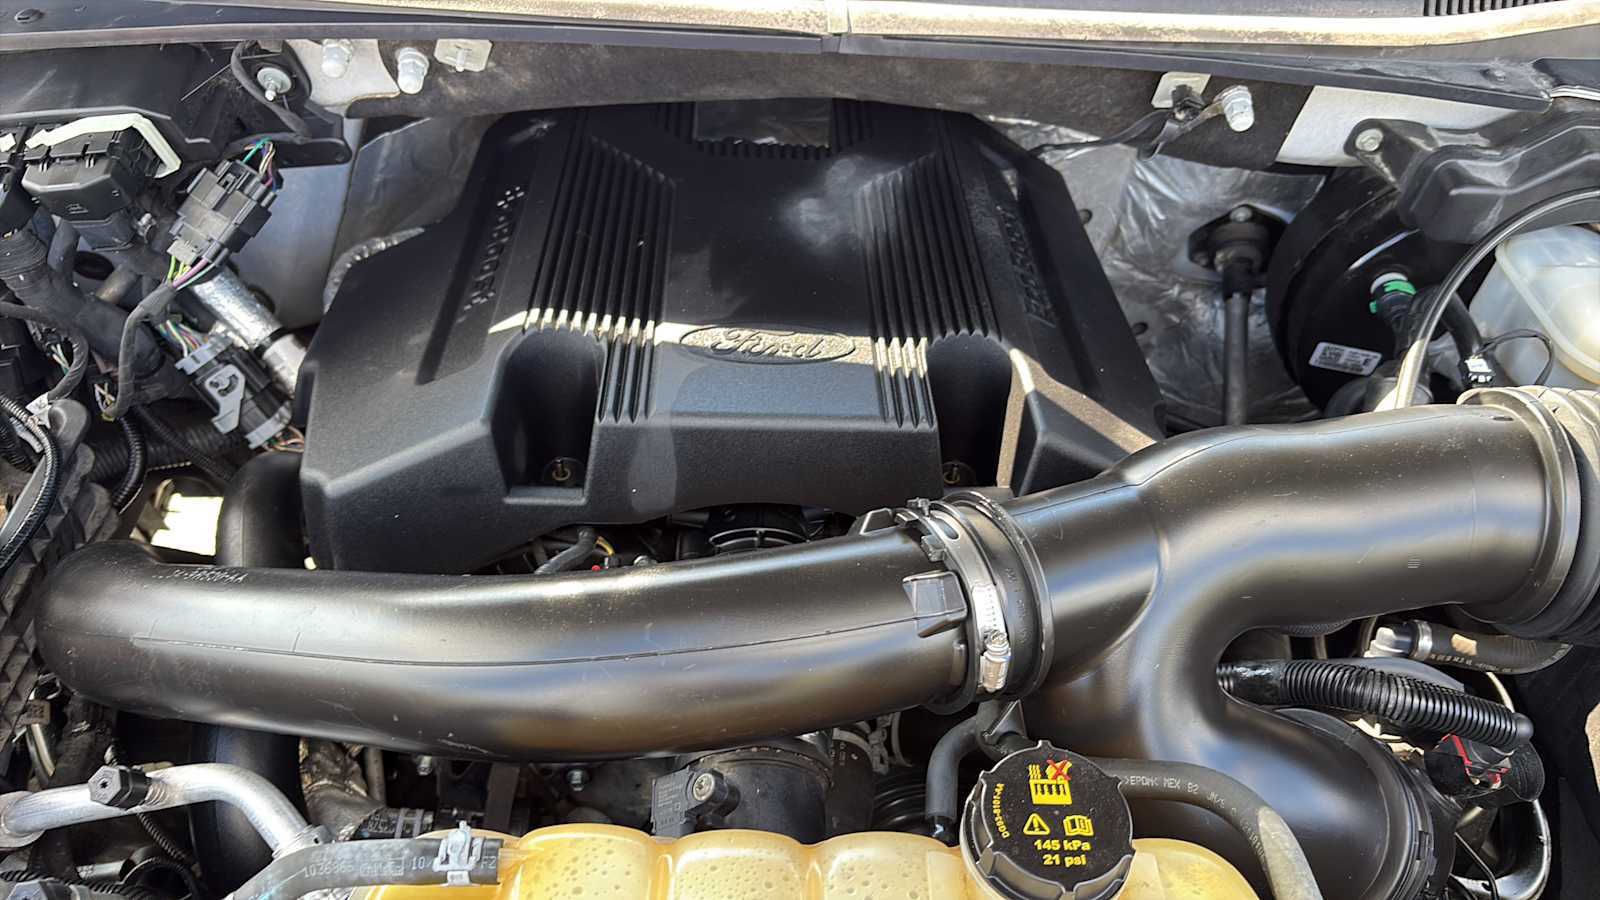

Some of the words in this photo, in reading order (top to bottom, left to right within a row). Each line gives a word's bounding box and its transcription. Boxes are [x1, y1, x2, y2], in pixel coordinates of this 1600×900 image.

[710, 328, 825, 357] Ford
[1034, 839, 1061, 851] 145
[1063, 839, 1091, 851] kPa
[1042, 854, 1060, 865] 21
[1064, 854, 1087, 867] psi
